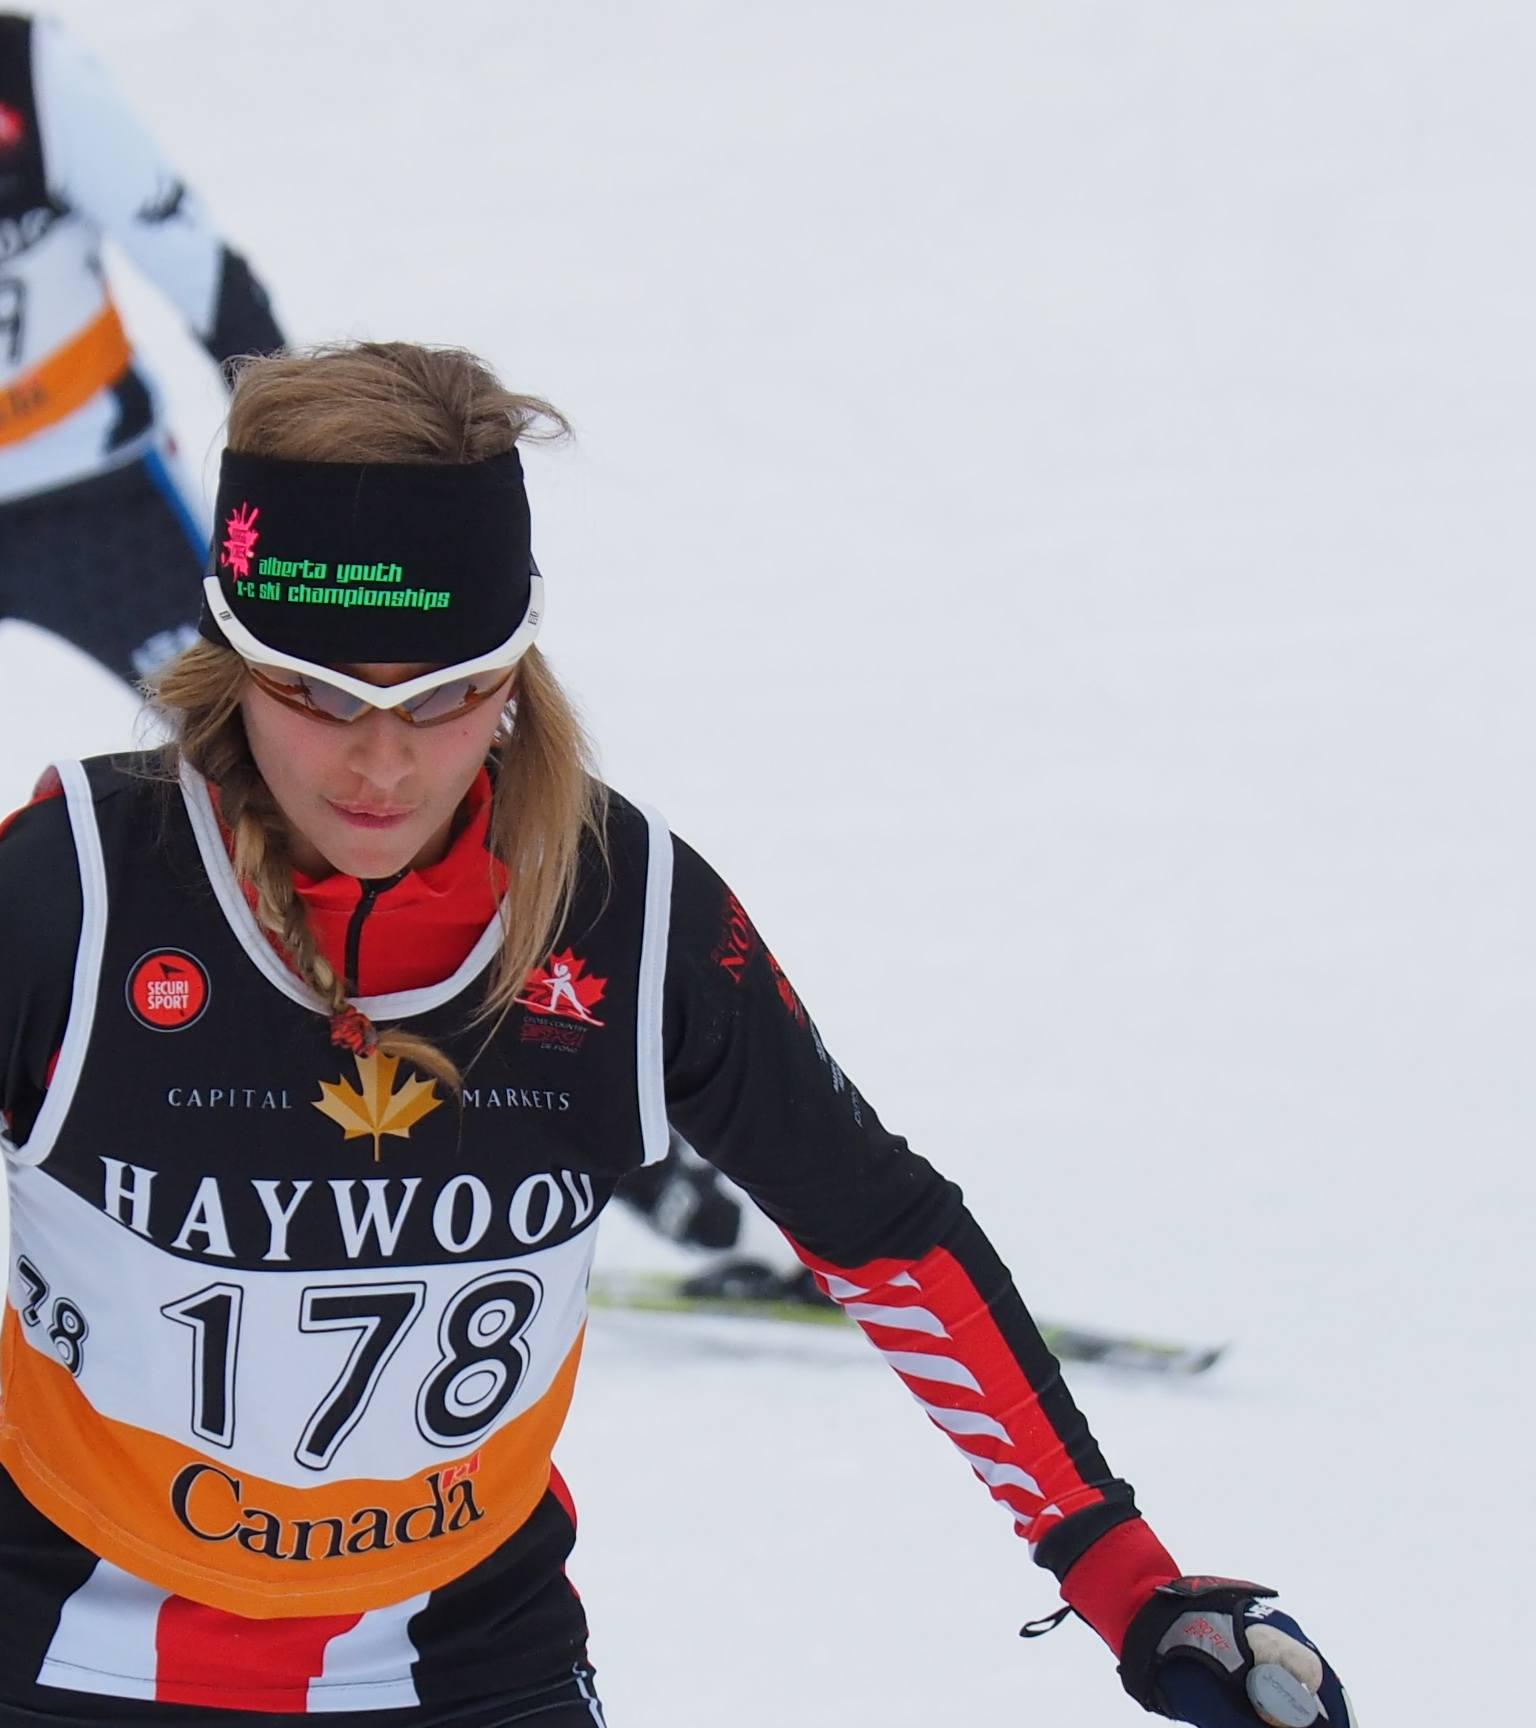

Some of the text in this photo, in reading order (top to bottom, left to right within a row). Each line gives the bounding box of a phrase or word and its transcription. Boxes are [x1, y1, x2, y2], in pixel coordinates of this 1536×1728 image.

[259, 557, 403, 583] alberta youth
[259, 582, 281, 601] ski
[288, 584, 450, 610] championships
[147, 981, 189, 995] SECURI
[147, 995, 190, 1010] SPORT
[167, 1087, 571, 1111] CAPITAL MARKETS
[160, 1268, 544, 1471] 178
[170, 1462, 485, 1562] Canada
